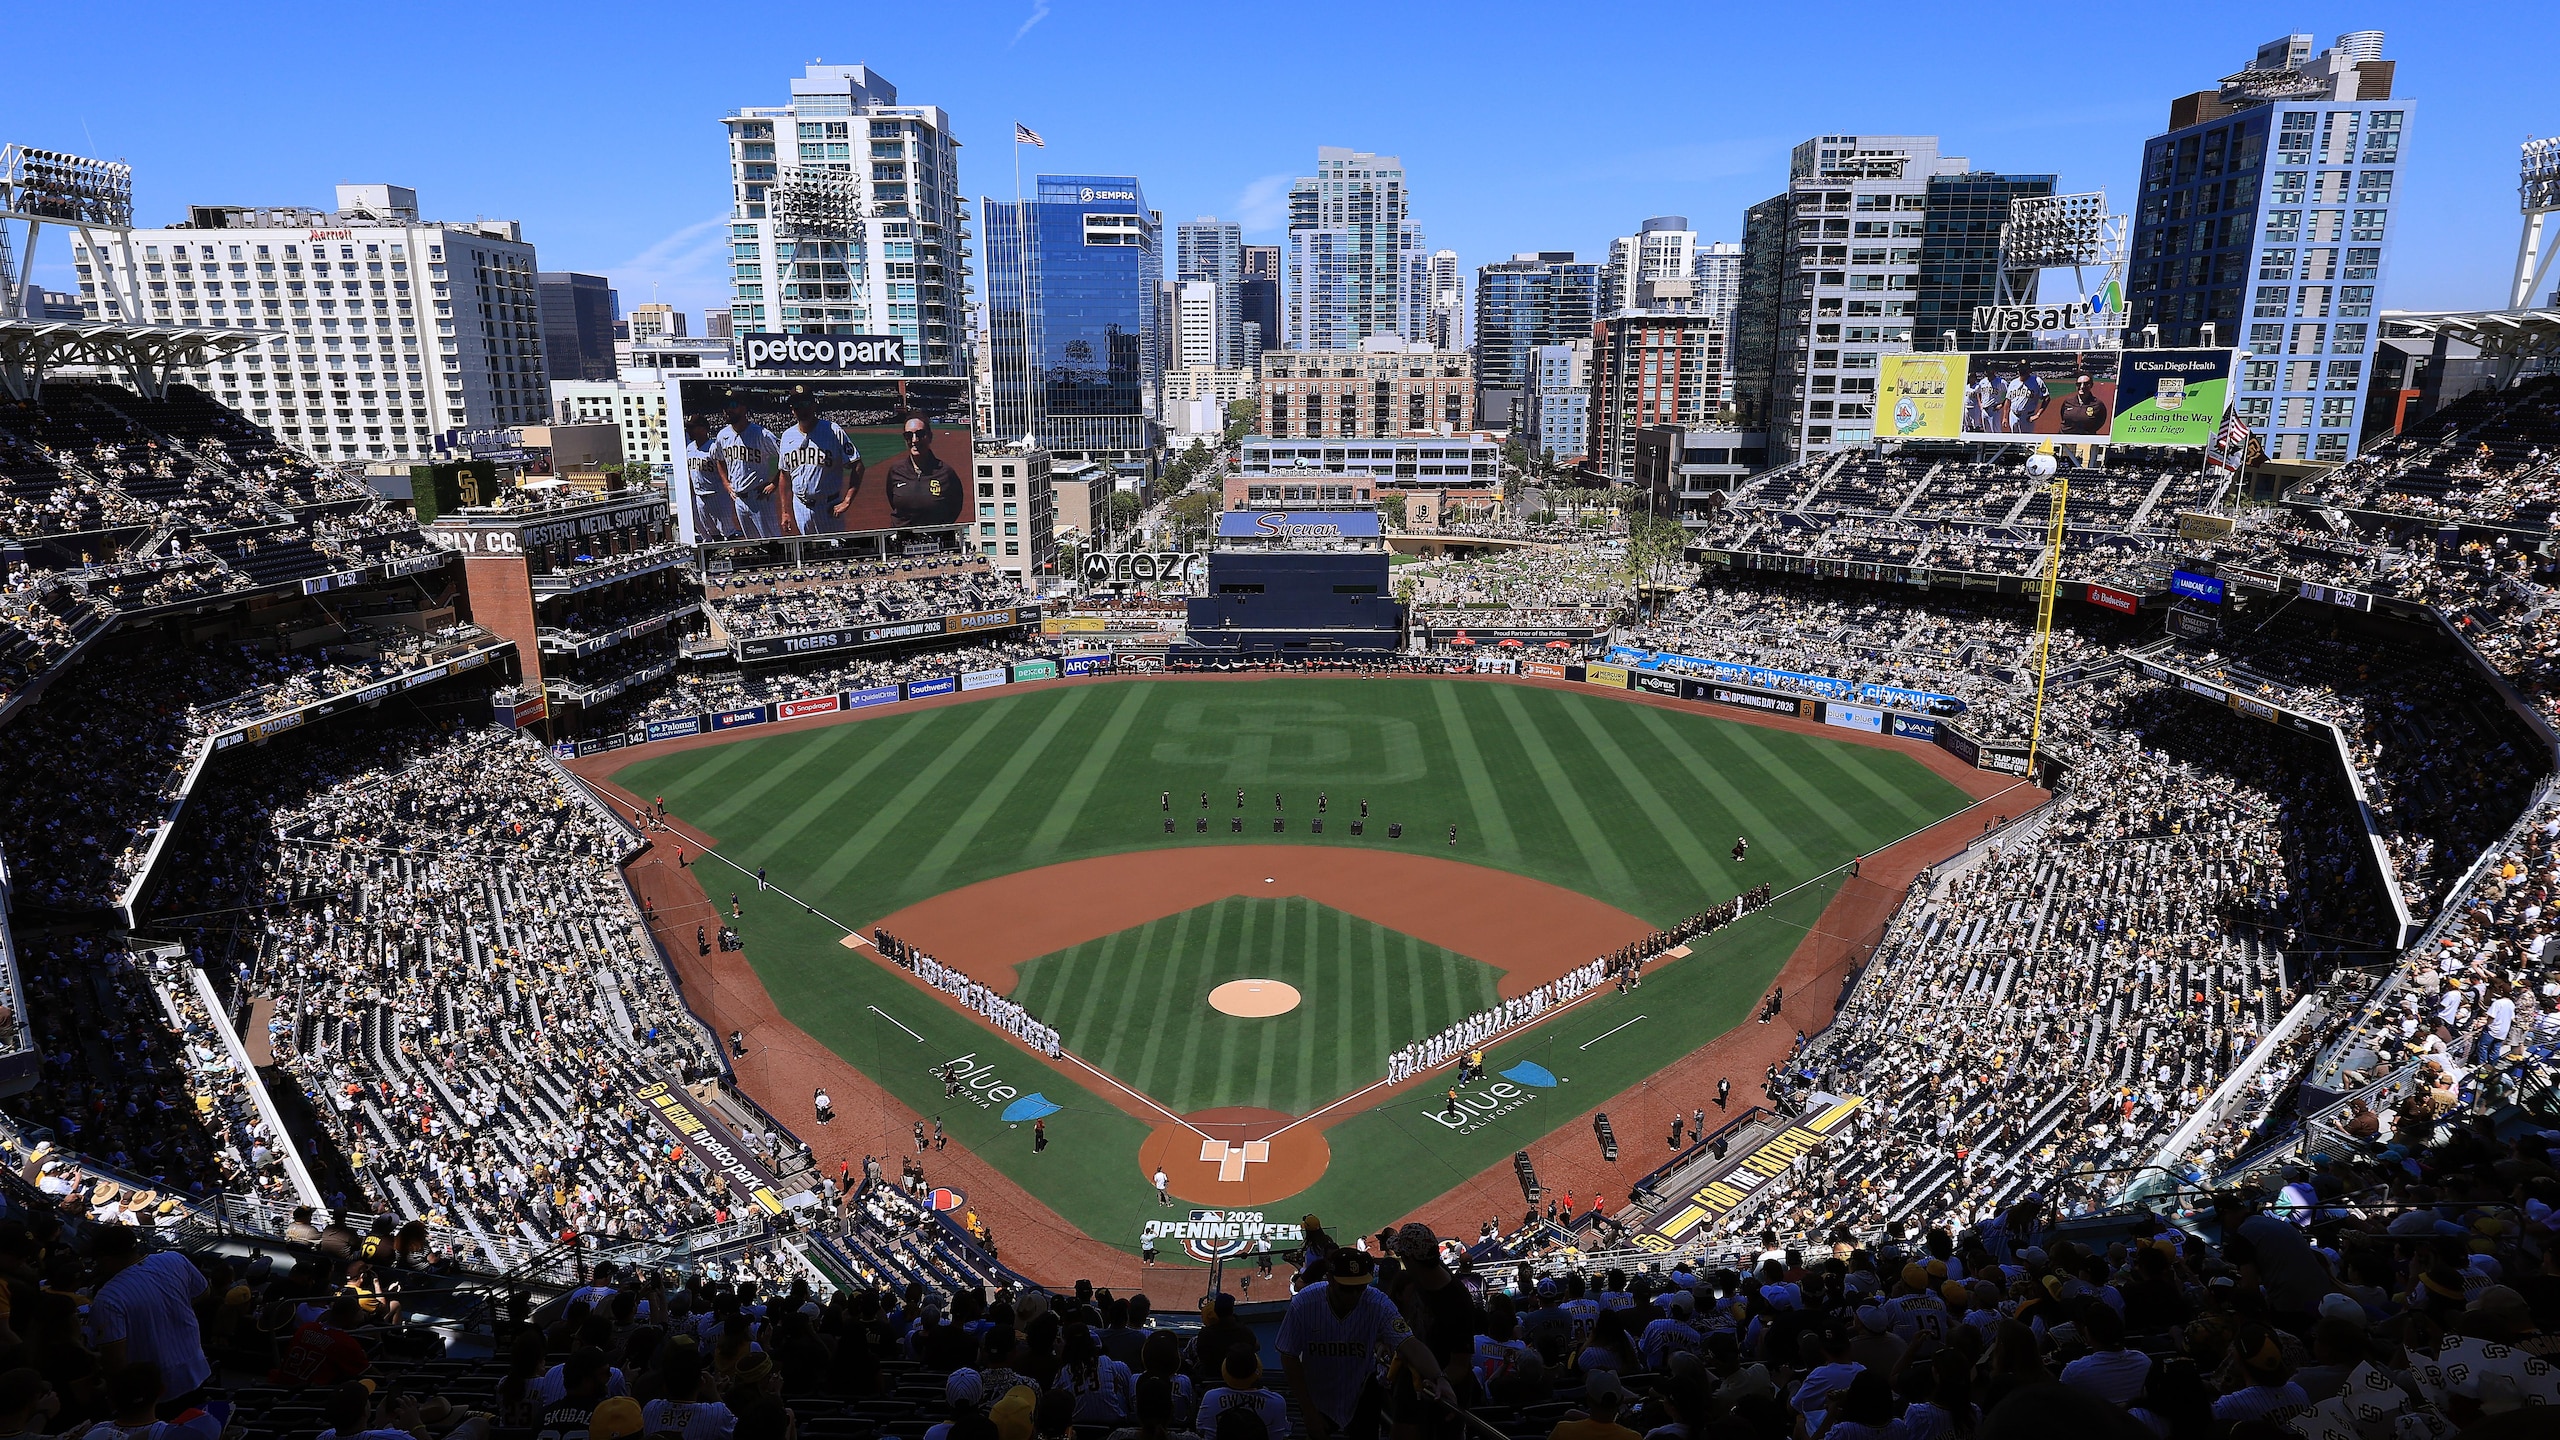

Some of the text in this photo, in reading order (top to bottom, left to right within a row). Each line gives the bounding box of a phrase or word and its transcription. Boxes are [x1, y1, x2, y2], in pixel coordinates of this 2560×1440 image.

[1096, 191, 1134, 200] SEMPRA
[309, 229, 352, 242] Marriott
[1977, 303, 2077, 332] Viasat
[748, 335, 902, 368] petco park
[2134, 361, 2216, 372] UC San Diego Health
[2129, 412, 2213, 424] Leading the Way
[2127, 425, 2137, 433] in
[2160, 426, 2185, 434] Diego
[784, 449, 833, 468] PADRES
[523, 503, 669, 548] WESTERN METAL SUPPLY CO.
[1255, 512, 1341, 543] Sycuan
[485, 531, 523, 553] CO.
[1114, 552, 1201, 582] razr
[1700, 551, 1731, 565] PADRES
[337, 573, 357, 587] 12:52
[2101, 591, 2131, 609] Budweiser
[2334, 590, 2356, 608] 12:52
[881, 611, 1010, 639] OPENING DAY 2026 PADRES
[783, 633, 838, 652] TIGERS
[1067, 659, 1098, 672] ARCO
[1600, 671, 1625, 679] MERCURY
[356, 686, 388, 704] TIGERS
[457, 654, 485, 670] PADRES
[861, 690, 897, 702] QuidelOrtho
[911, 683, 947, 695] Southwest
[2142, 664, 2168, 682] TIGERS
[2238, 698, 2274, 720] PADRES
[796, 701, 833, 713] Snapdragon
[1731, 692, 1762, 707] OPENING
[1762, 695, 1775, 709] DAY
[1776, 698, 1794, 712] 2026
[662, 720, 697, 732] Palomar
[723, 712, 755, 724] us bank
[1828, 710, 1844, 719] blue
[1854, 714, 1873, 723] blue
[229, 732, 244, 746] 2026
[260, 714, 301, 736] PADRES
[628, 732, 644, 744] 342
[1993, 760, 2013, 770] CHEESE
[1994, 753, 2011, 764] SLAP
[941, 1052, 1017, 1102] blue
[929, 1067, 991, 1110] CALFORNIA
[1421, 1082, 1522, 1129] blue
[1459, 1093, 1538, 1136] CALIFORNIA
[660, 1102, 707, 1136] WELCOME
[700, 1134, 738, 1167] petco
[721, 1163, 765, 1191] park
[1690, 1126, 1827, 1214] FOR THE FAITHFUL
[1226, 1211, 1264, 1223] 2026
[1144, 1220, 1304, 1241] OPENING WEEK
[302, 1328, 336, 1347] TROUT
[1915, 1315, 1941, 1341] 13
[1308, 1341, 1366, 1359] PADRES
[283, 1346, 327, 1382] 27
